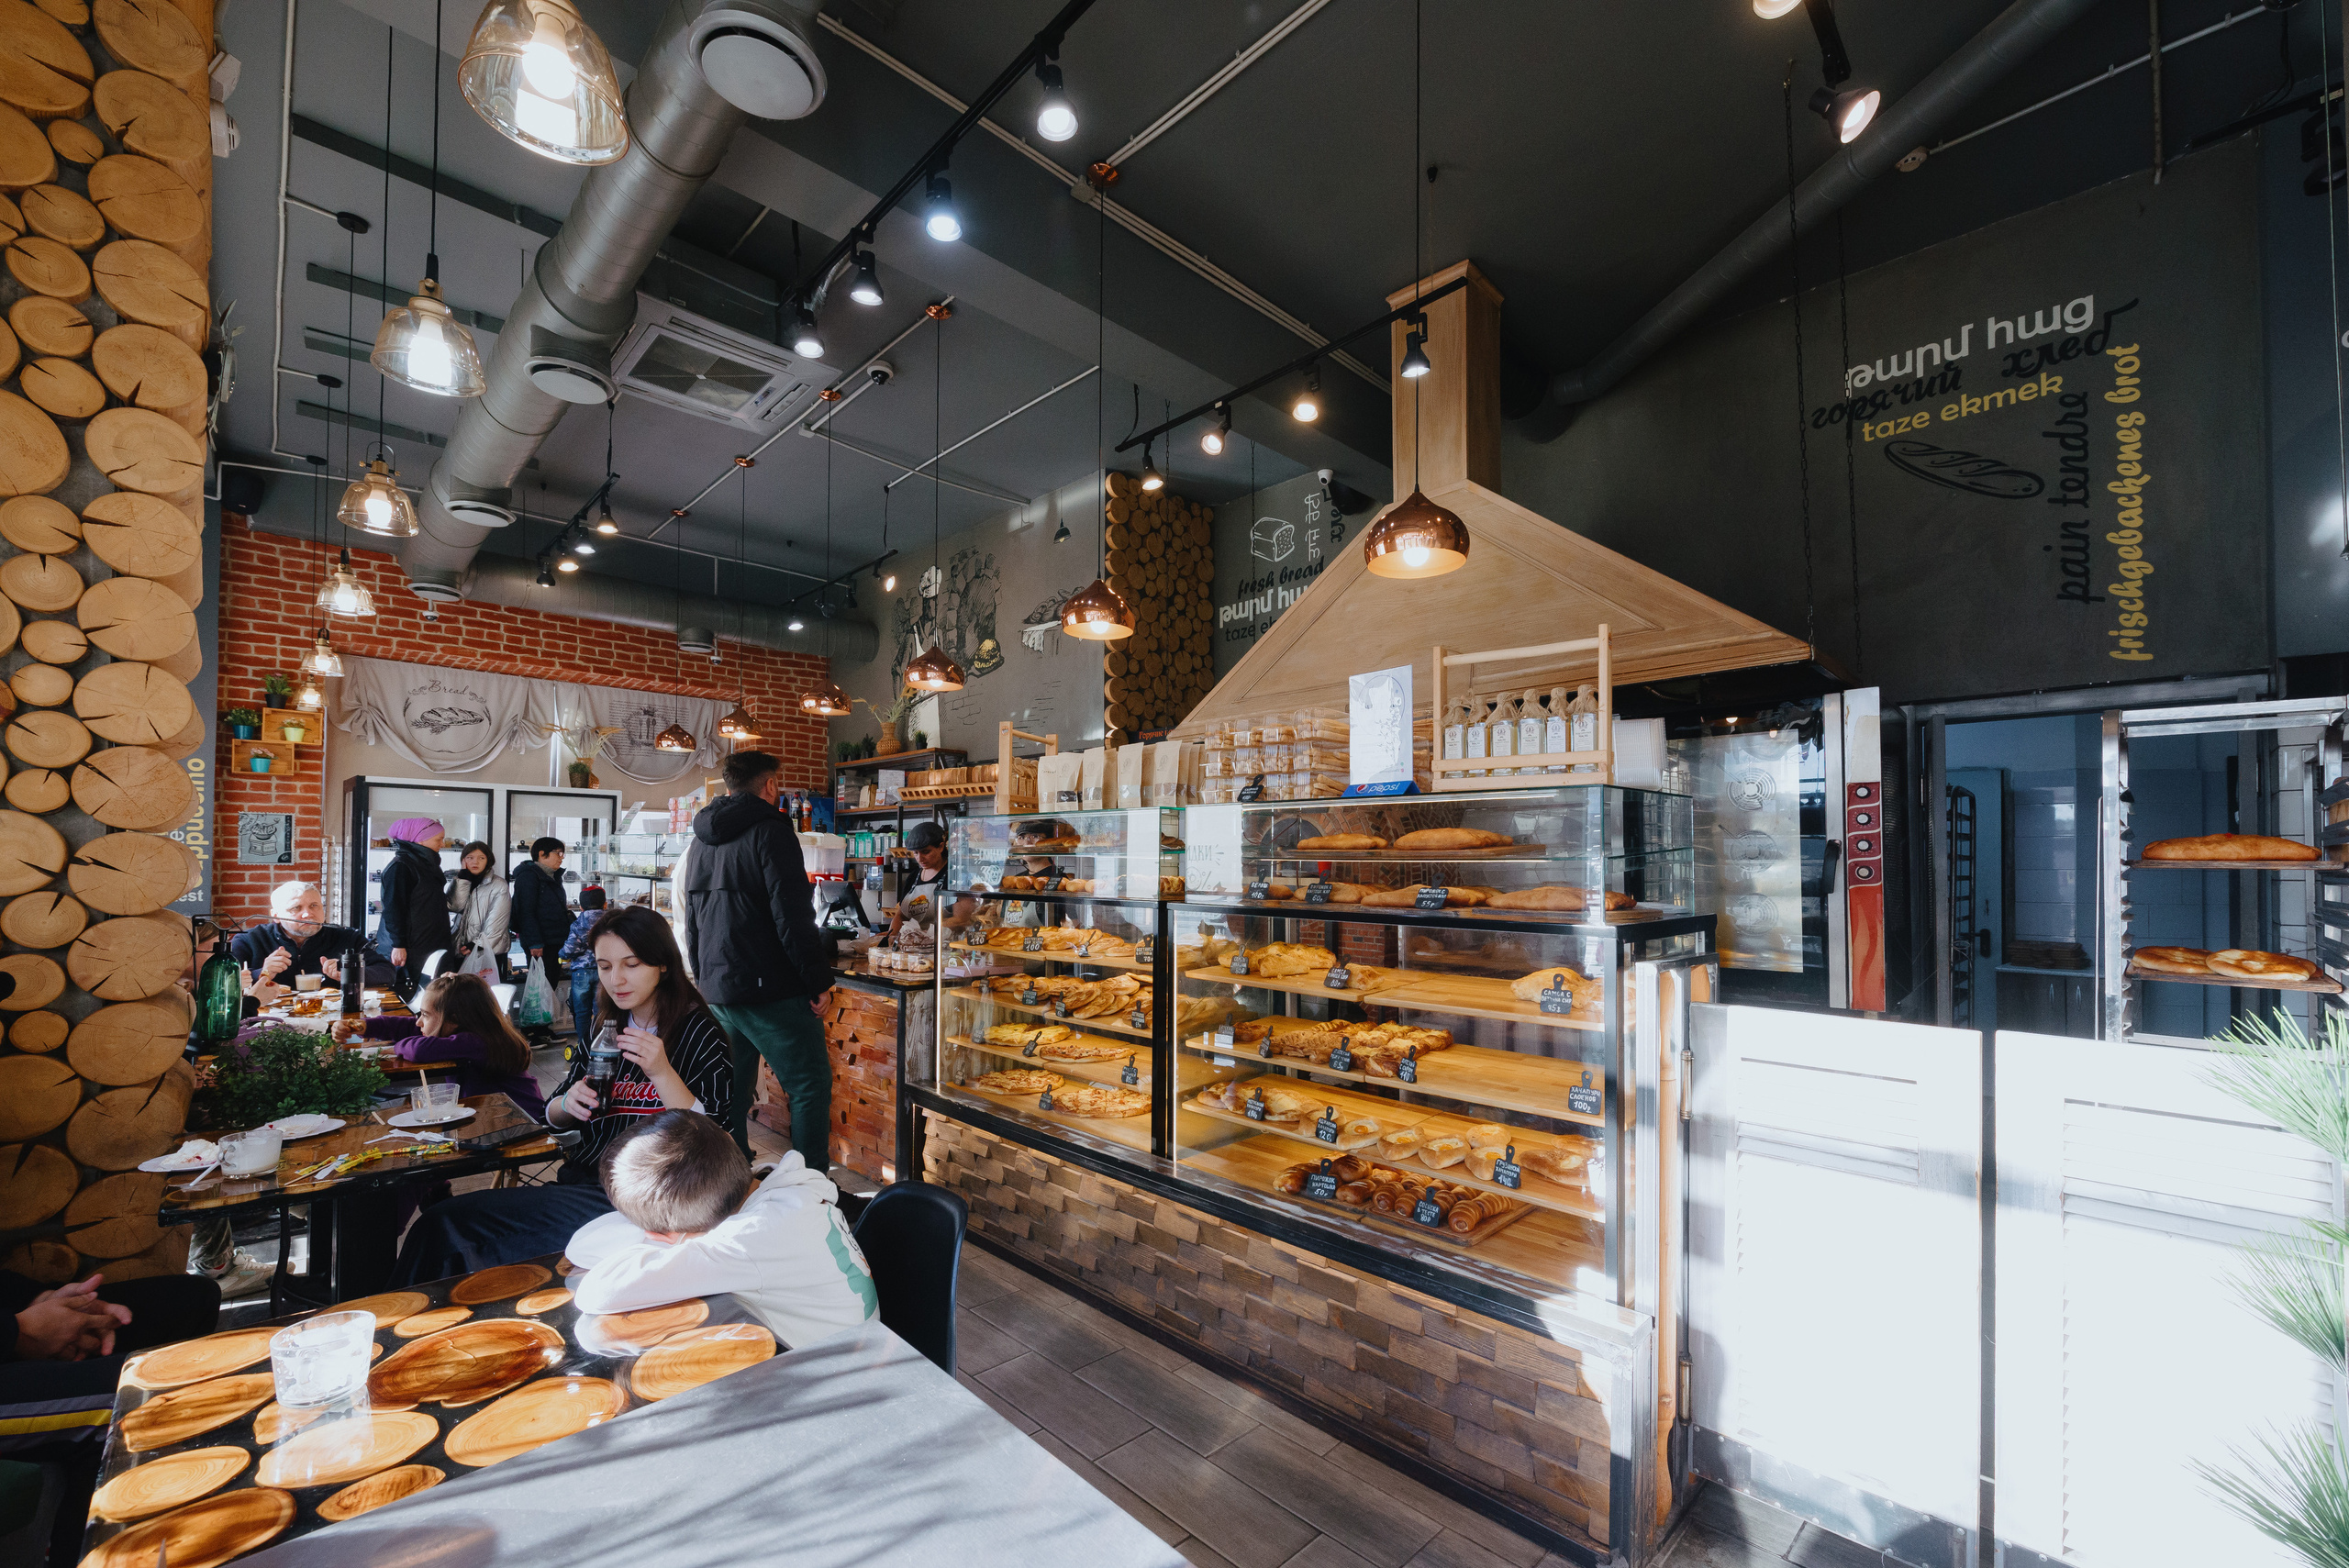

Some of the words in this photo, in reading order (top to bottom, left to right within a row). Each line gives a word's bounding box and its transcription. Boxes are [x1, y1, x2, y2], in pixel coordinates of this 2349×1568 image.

[2103, 342, 2141, 404] brot
[1862, 411, 1931, 442] taze
[1940, 372, 2064, 423] ekmek
[2042, 391, 2090, 509] tendre
[2106, 410, 2154, 662] frischgebackenes
[2043, 518, 2106, 605] pain
[1237, 571, 1275, 600] fresh
[1279, 555, 1325, 585] bread
[1225, 624, 1255, 642] taze
[428, 679, 470, 695] Bread
[1367, 782, 1400, 794] pepsi
[1026, 943, 1041, 951] 100
[1543, 989, 1564, 997] САМСА
[1571, 1086, 1601, 1097] ХАЧАПУРИ
[1310, 1174, 1335, 1184] ПИРОЖОК
[1419, 1200, 1439, 1213] СОСИСКА
[1421, 1208, 1435, 1218] ТЕСТЕ
